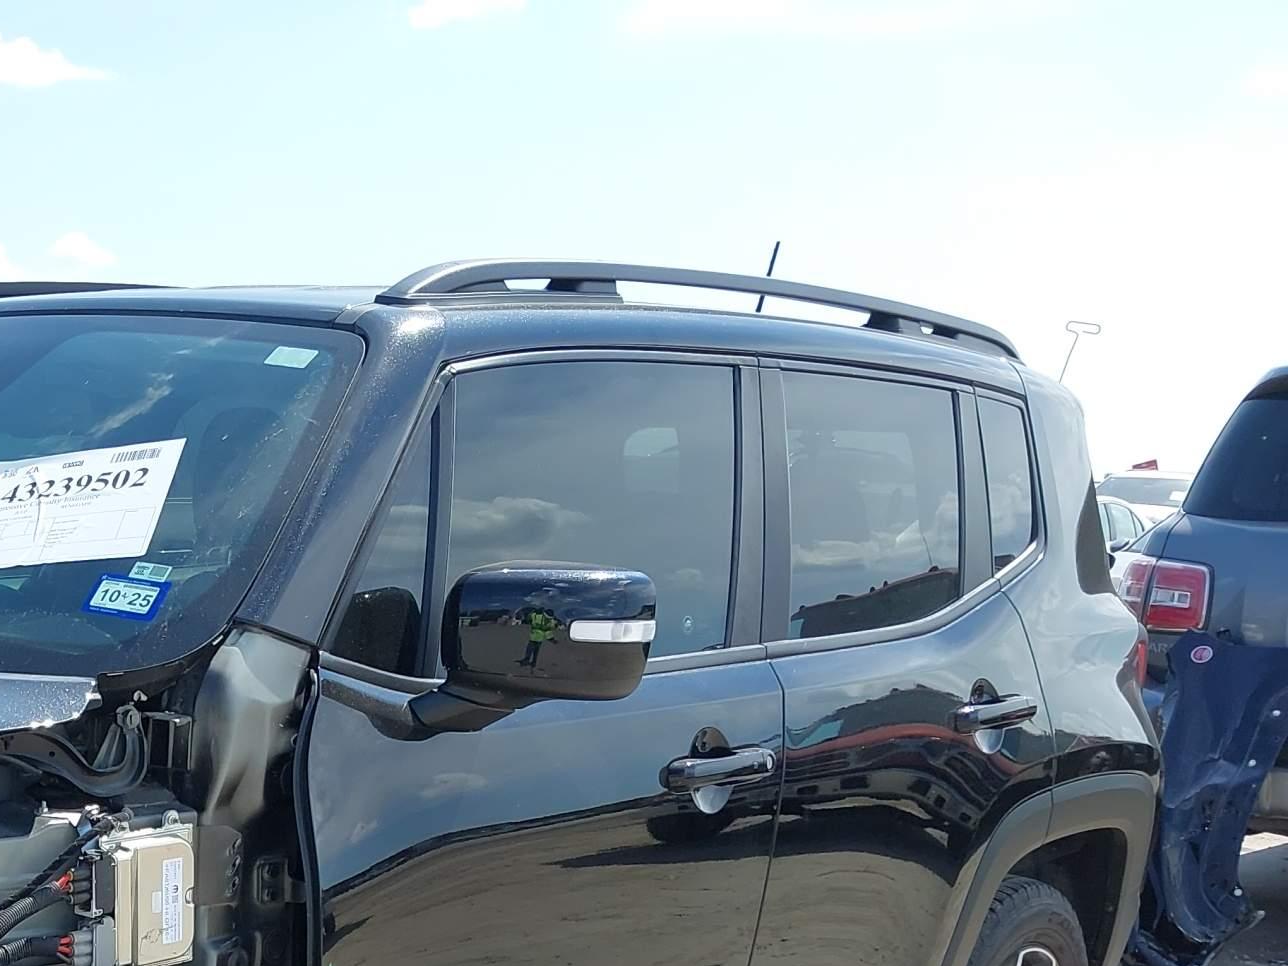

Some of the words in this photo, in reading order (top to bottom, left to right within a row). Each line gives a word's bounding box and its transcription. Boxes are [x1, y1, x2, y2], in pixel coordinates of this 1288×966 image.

[0, 466, 150, 504] 43239502
[100, 588, 122, 603] 10
[127, 592, 154, 608] 25
